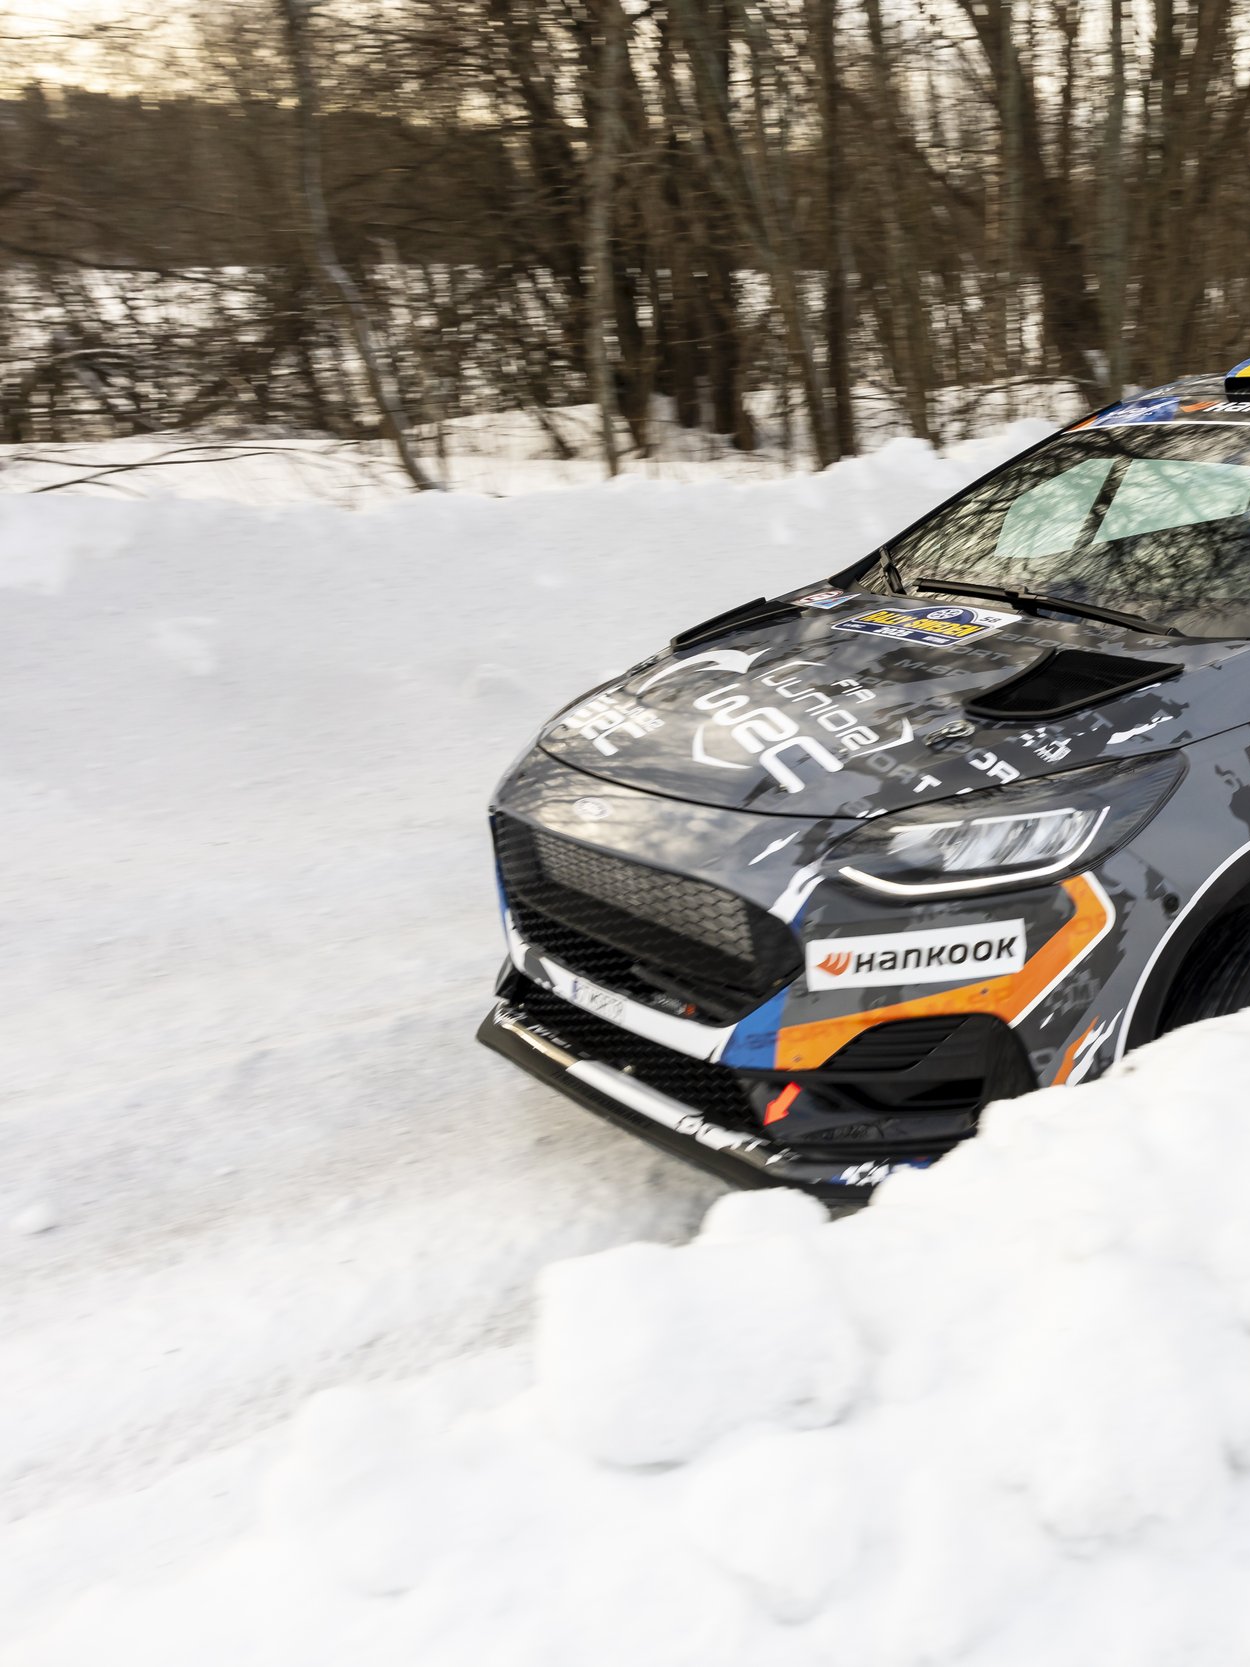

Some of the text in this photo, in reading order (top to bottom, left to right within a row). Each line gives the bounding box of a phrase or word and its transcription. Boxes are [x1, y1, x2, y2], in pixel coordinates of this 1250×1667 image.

[858, 611, 986, 638] RALLY SWEDEN
[980, 615, 1001, 624] 58
[830, 678, 877, 704] FIA
[760, 674, 880, 751] JUNIOR
[692, 682, 845, 794] WRC
